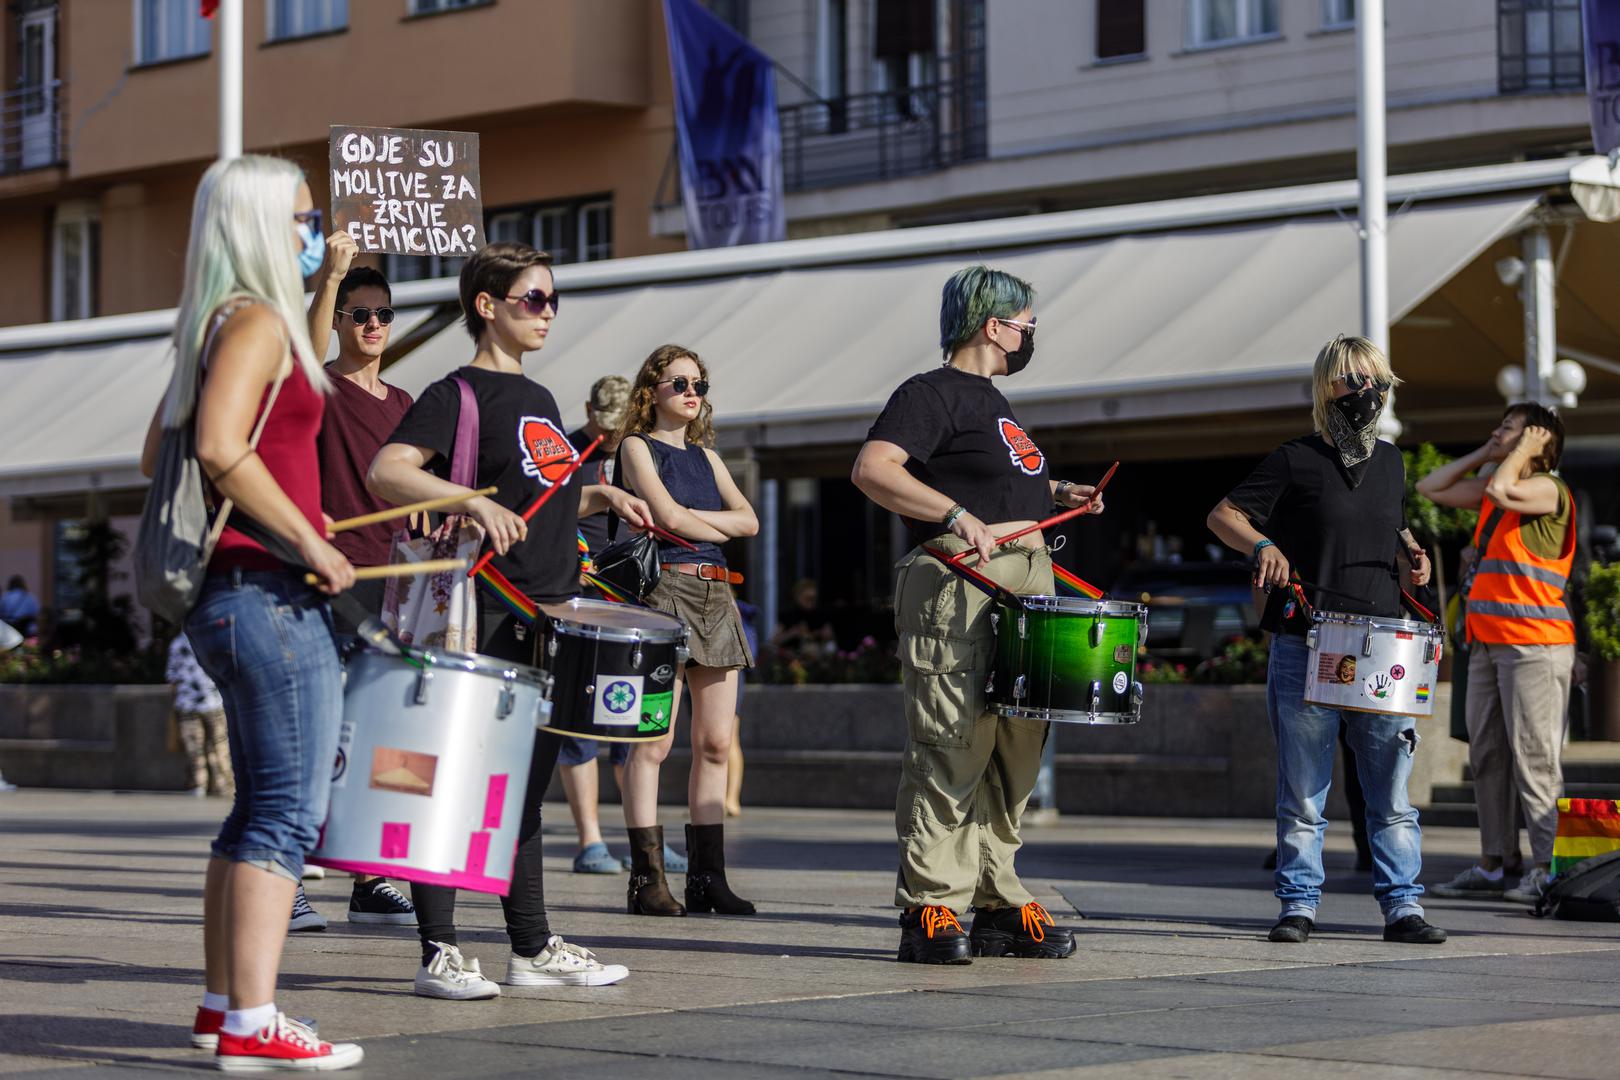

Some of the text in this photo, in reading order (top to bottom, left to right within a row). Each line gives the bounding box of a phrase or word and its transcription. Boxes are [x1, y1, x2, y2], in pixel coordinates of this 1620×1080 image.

[341, 133, 454, 168] GDJE SU
[333, 168, 477, 200] MOLITVE ZA
[372, 193, 447, 227] ŽRTVE
[347, 221, 477, 255] FEMICIDA?
